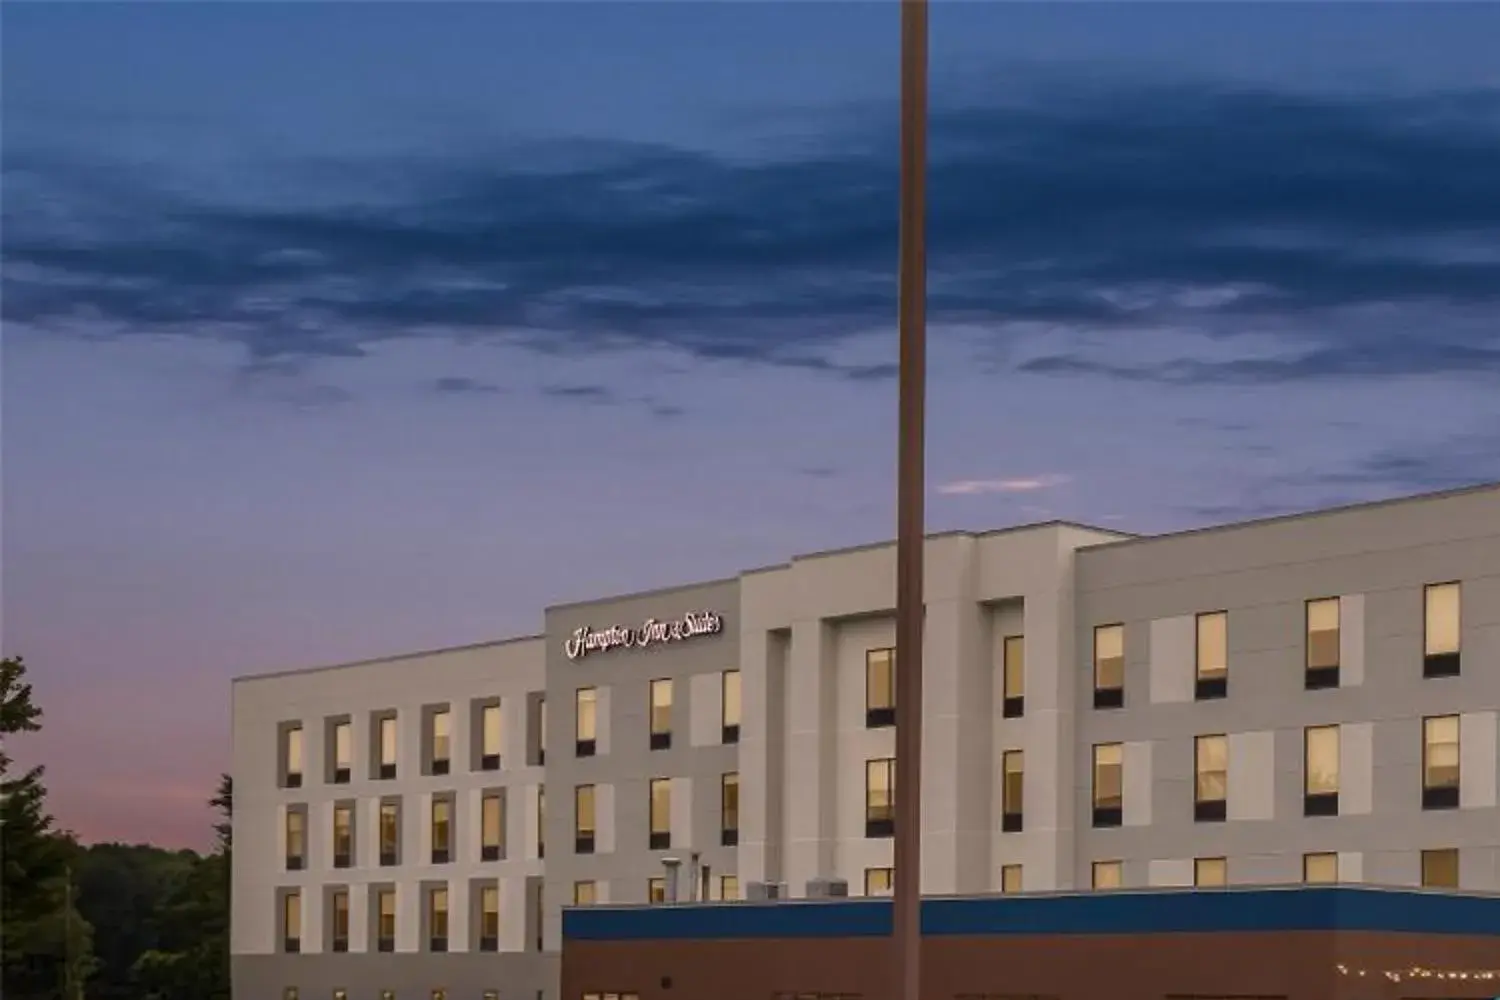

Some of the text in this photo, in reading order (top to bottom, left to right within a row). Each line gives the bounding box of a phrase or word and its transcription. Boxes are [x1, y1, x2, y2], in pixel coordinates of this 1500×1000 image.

[565, 625, 634, 659] Hampton
[637, 618, 671, 647] Inn
[682, 611, 722, 638] Suites
